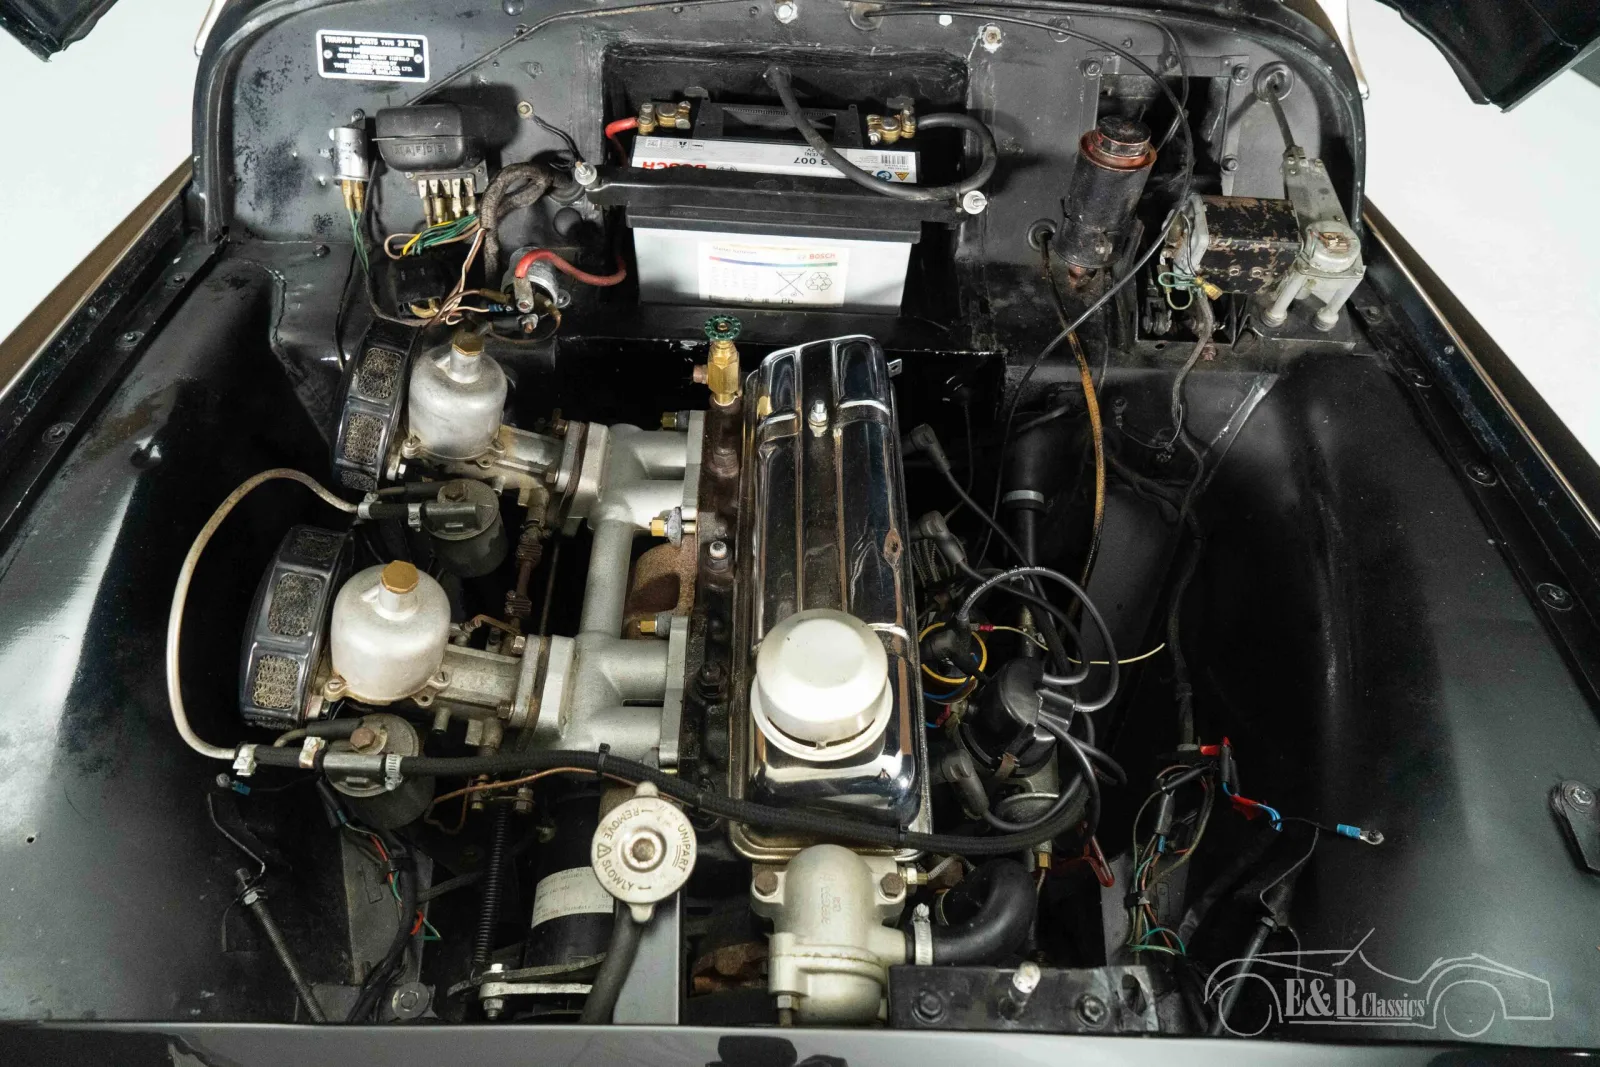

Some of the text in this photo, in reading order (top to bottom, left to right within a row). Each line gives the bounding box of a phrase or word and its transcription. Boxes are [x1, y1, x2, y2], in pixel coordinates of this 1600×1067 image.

[794, 157, 816, 165] 007
[604, 807, 640, 841] REMOVE
[678, 824, 691, 873] UNIPART
[602, 859, 635, 891] SLOWLY
